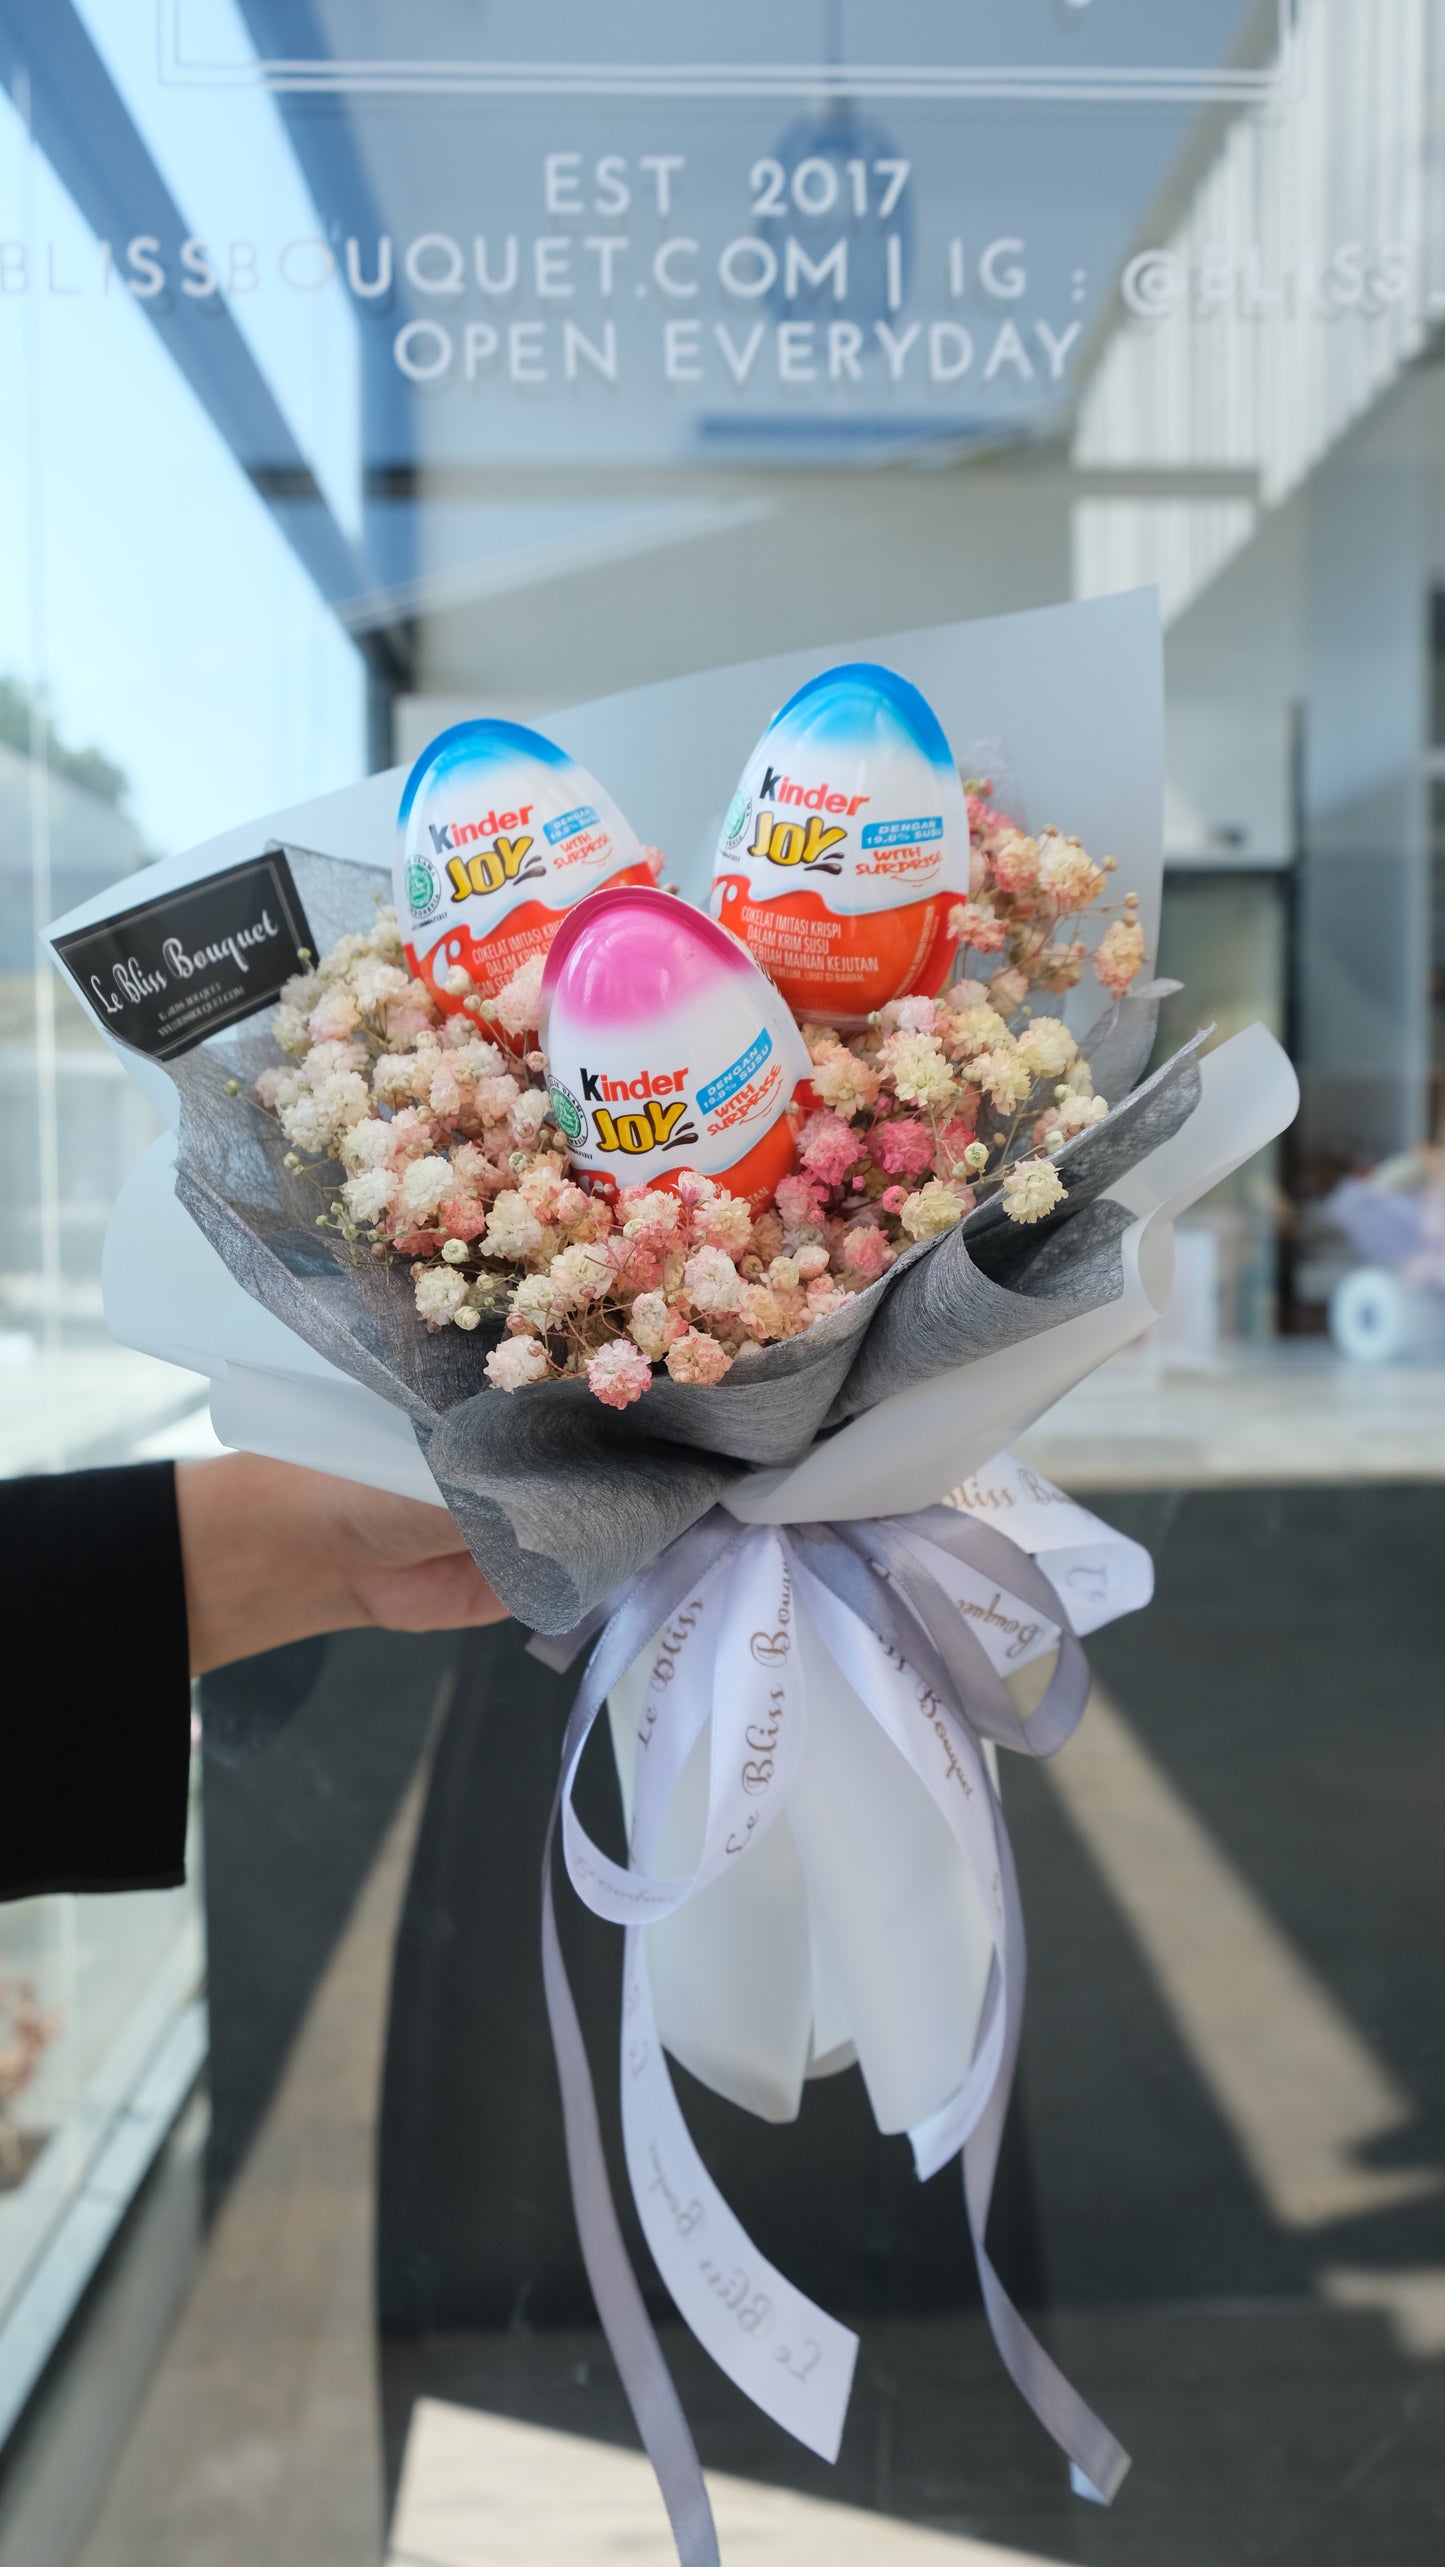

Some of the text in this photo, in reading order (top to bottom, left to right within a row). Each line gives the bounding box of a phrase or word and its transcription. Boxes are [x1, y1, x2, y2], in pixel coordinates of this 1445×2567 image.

[543, 152, 913, 219] EST 2017
[949, 237, 1028, 300] IG
[393, 320, 1083, 383] OPEN EVERYDAY
[759, 766, 871, 816] kinder
[428, 804, 534, 854] kinder
[559, 832, 592, 854] WITH
[747, 811, 848, 867] JOY
[878, 820, 937, 835] DENGAN
[445, 836, 534, 903] JOY
[855, 850, 943, 875] SURPRISE
[873, 846, 920, 862] WITH
[472, 936, 508, 964] COKELAT
[508, 925, 544, 954] IMITASI
[741, 904, 842, 938] COKELAT IMITASI KRISPI
[747, 924, 776, 947] DALAM
[777, 933, 802, 951] KRIM
[803, 938, 829, 954] SUSU
[90, 974, 124, 1015] Le
[112, 955, 168, 1004] Bliss
[162, 908, 280, 979] Bouquet
[486, 949, 520, 978] DALAM
[784, 950, 825, 971] MAINAN
[826, 955, 879, 973] KEJUTAN
[580, 1067, 689, 1102] kinder
[703, 1044, 769, 1108] 19.8% SUSU
[707, 1046, 758, 1096] DENGAN
[707, 1064, 782, 1136] SURPRISE
[714, 1083, 755, 1118] WITH
[591, 1100, 687, 1155] JOY
[741, 1682, 786, 1797] Bliss
